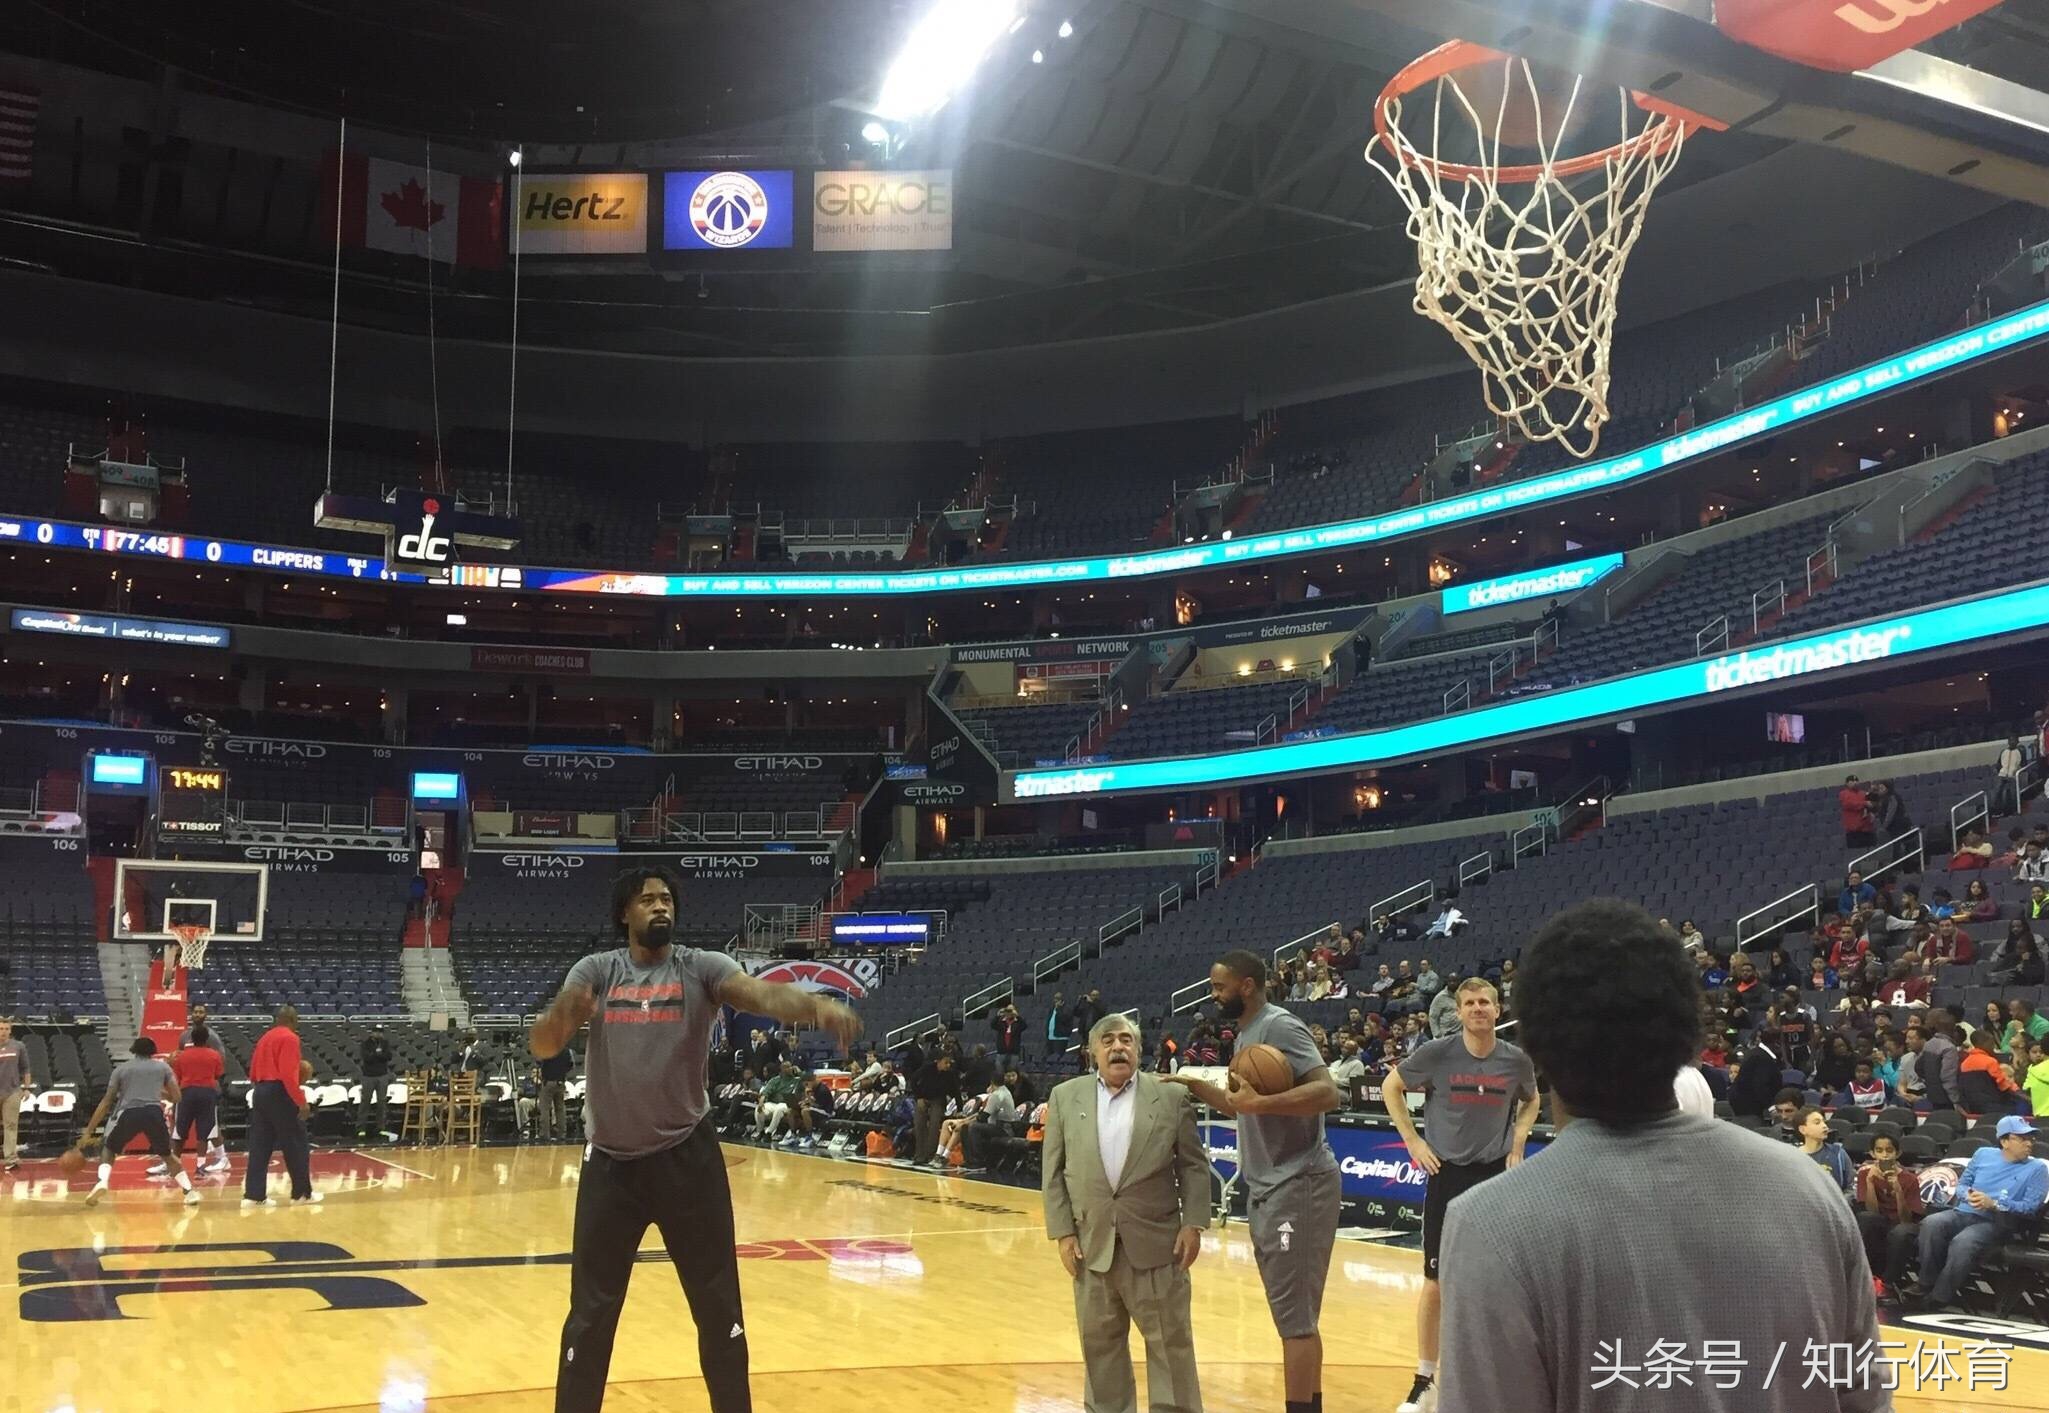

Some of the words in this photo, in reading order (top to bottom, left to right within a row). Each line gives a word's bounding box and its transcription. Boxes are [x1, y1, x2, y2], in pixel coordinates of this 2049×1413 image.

[816, 182, 946, 216] GRACE
[525, 192, 623, 220] Hertz
[816, 223, 845, 233] Talent
[856, 223, 910, 234] Technology
[1792, 392, 1823, 414] BUY
[1826, 379, 1861, 400] AND
[1865, 364, 1903, 389] SELL
[37, 523, 53, 543] 0
[206, 542, 222, 562] 0
[252, 549, 323, 570] CLIPPERS
[1468, 567, 1594, 607] ticketmaster
[1260, 621, 1331, 638] ticketmaster
[958, 647, 1031, 661] MONUMENTAL
[1077, 641, 1130, 655] NETWORK
[567, 656, 584, 668] CLUB
[1705, 625, 1910, 692] ticketmaster
[56, 728, 78, 739] 106
[155, 734, 176, 745] 105
[225, 739, 326, 758] ETIHAD
[373, 749, 392, 758] 105
[931, 736, 960, 760] ETIHAD
[464, 752, 483, 761] 104
[523, 754, 615, 769] ETIHAD
[734, 756, 823, 770] ETIHAD
[884, 756, 900, 765] 104
[904, 784, 965, 797] ETIHAD
[915, 797, 954, 805] AIRWAYS
[180, 821, 222, 831] TISSOT
[53, 839, 78, 850] 106
[245, 847, 334, 862] ETIHAD
[387, 853, 409, 863] 105
[809, 855, 830, 866] 104
[502, 855, 584, 868] ETIHAD
[680, 856, 759, 868] ETIHAD
[516, 870, 569, 878] AIRWAYS
[694, 870, 744, 879] AIRWAYS
[1891, 989, 1906, 1006] 8
